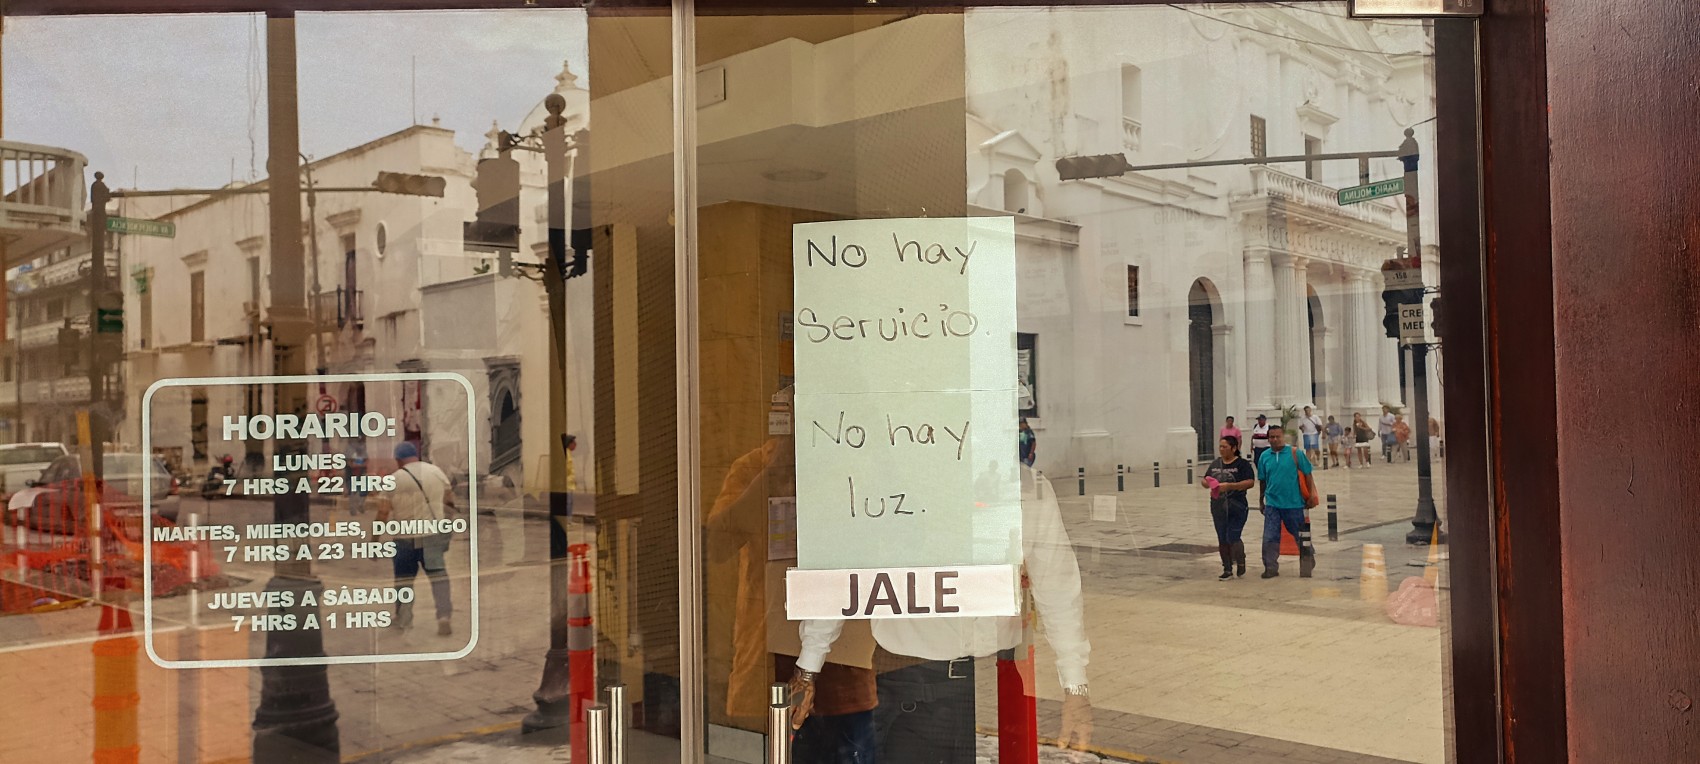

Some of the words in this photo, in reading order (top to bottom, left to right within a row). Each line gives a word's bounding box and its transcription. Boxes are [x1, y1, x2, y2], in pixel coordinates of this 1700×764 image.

[807, 235, 868, 268] No
[892, 232, 977, 275] hay
[1402, 309, 1424, 318] CRE
[222, 412, 396, 441] HORARIO:
[812, 411, 866, 449] No
[887, 413, 969, 460] hay
[273, 453, 346, 471] LUNES
[223, 480, 237, 496] 7
[244, 478, 289, 495] HRS
[296, 478, 312, 494] A
[318, 476, 344, 493] 22
[351, 475, 397, 492] HRS
[848, 476, 926, 518] luz.
[153, 525, 240, 543] MARTES,
[246, 522, 366, 540] MIERCOLES,
[373, 518, 467, 535] DOMINGO
[223, 547, 238, 563] 7
[245, 545, 290, 562] HRS
[296, 545, 312, 561] A
[318, 543, 345, 560] 23
[351, 542, 397, 559] HRS
[207, 591, 295, 610] JUEVES
[301, 590, 318, 607] A
[842, 571, 960, 617] JALE
[231, 615, 245, 632] 7
[251, 614, 297, 632] HRS
[302, 613, 320, 630] A
[326, 612, 337, 629] 1
[345, 611, 392, 629] HRS
